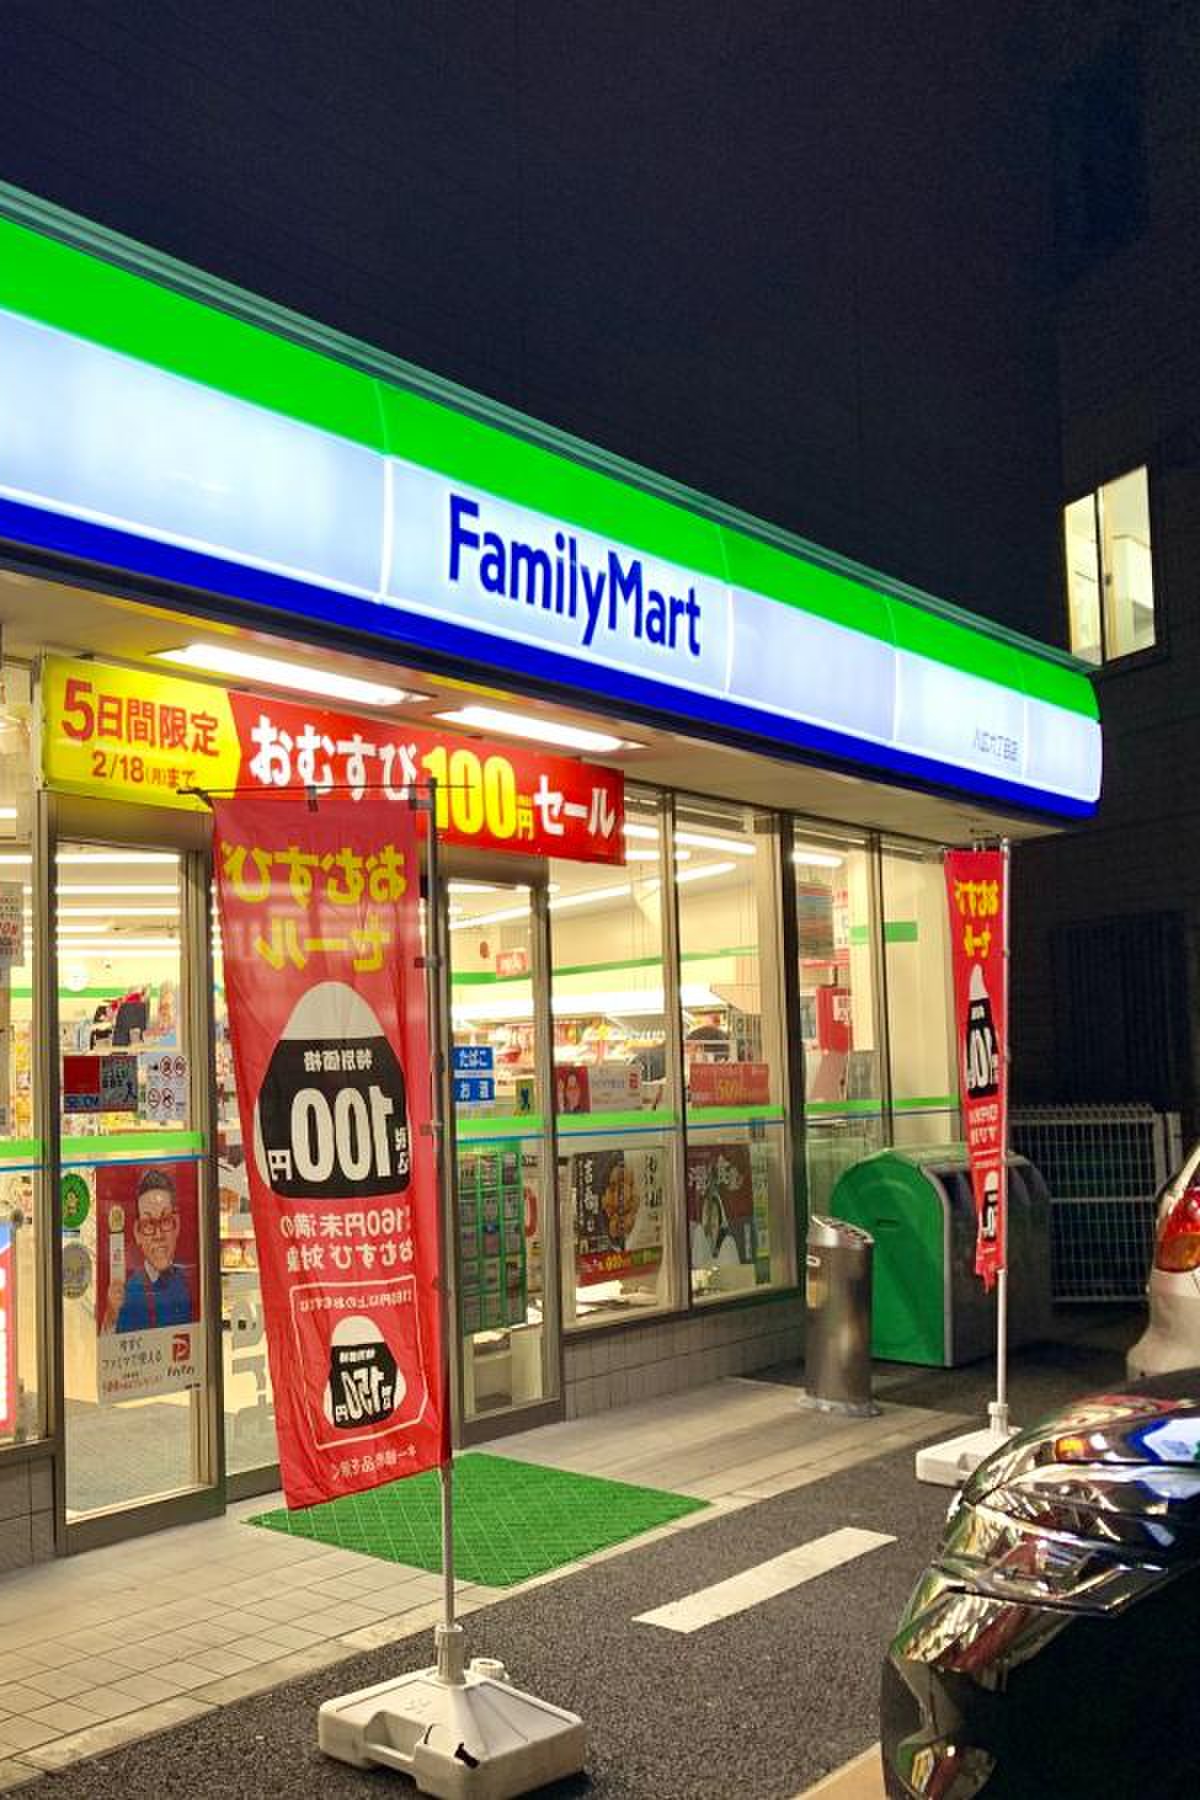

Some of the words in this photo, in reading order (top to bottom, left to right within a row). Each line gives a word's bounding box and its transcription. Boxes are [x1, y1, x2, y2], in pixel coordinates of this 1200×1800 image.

[448, 493, 703, 658] FamilyMart
[62, 678, 220, 757] 5日間限定
